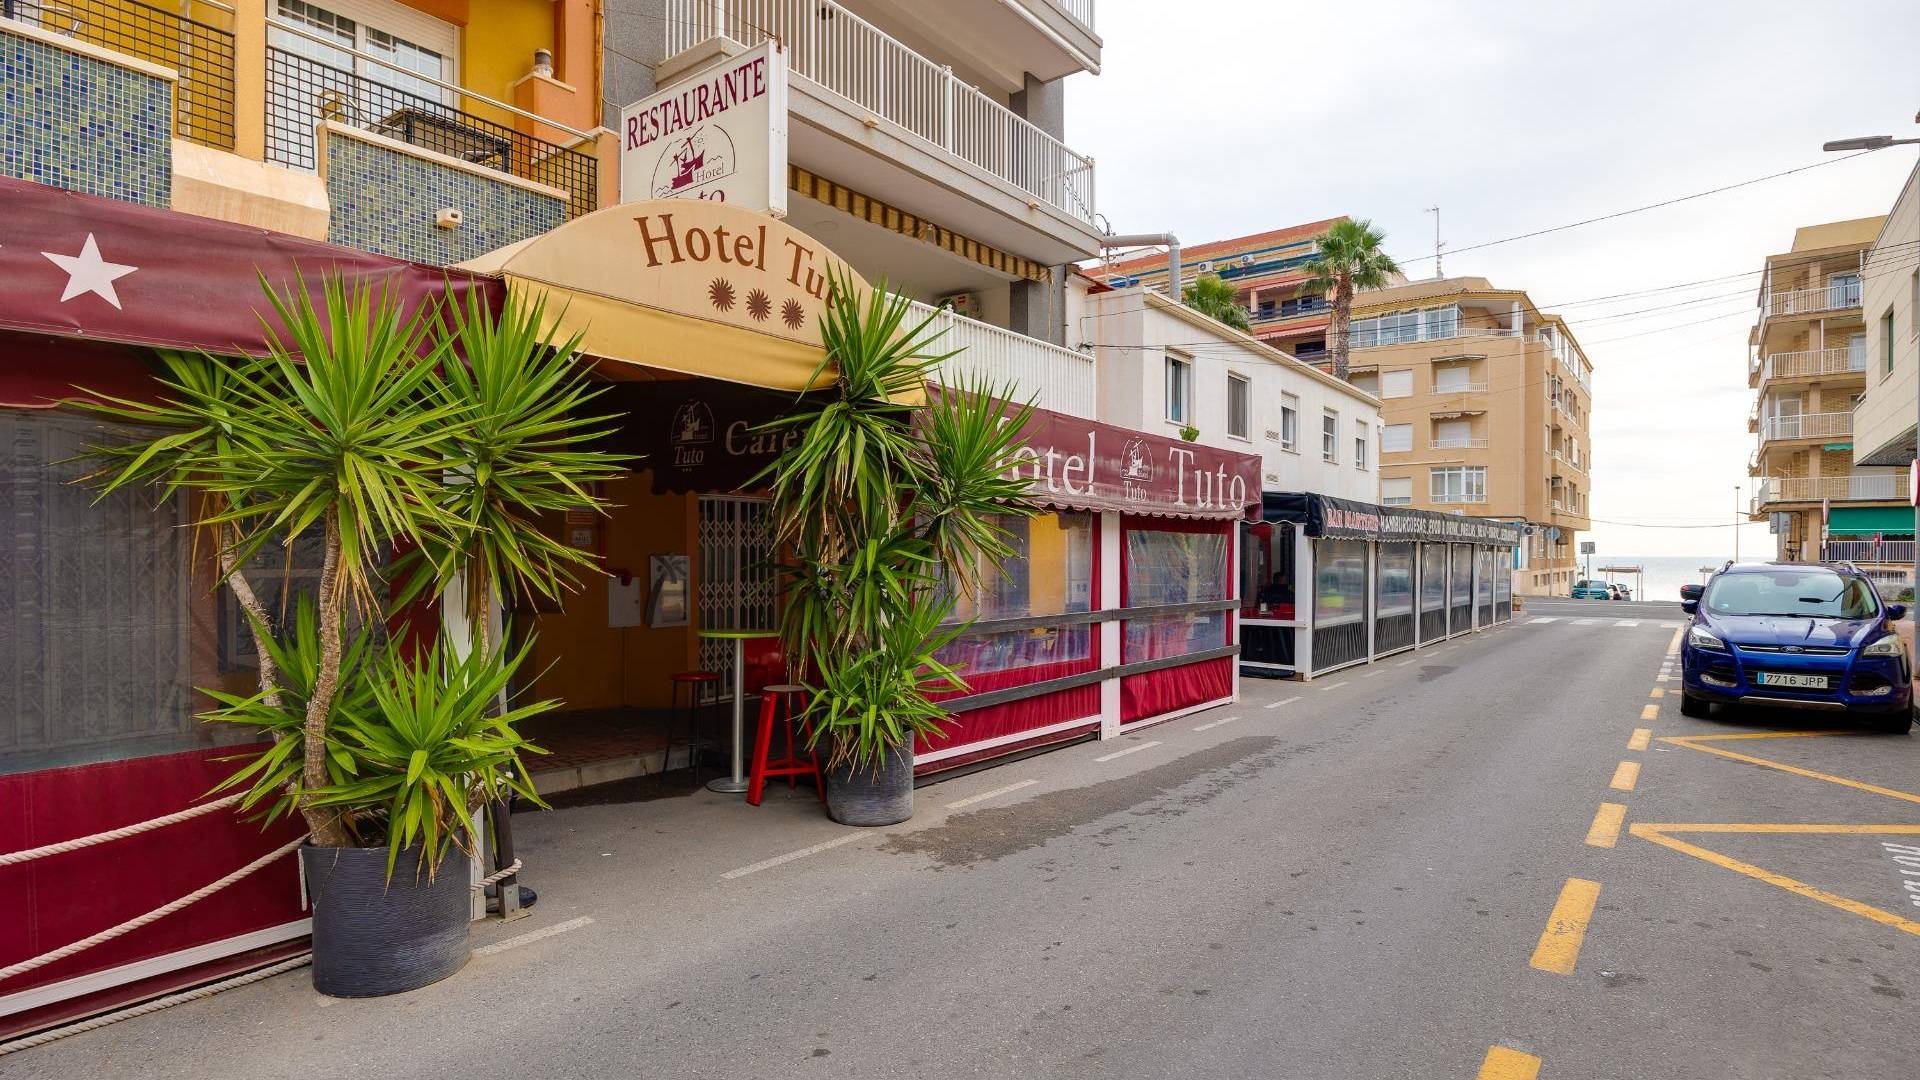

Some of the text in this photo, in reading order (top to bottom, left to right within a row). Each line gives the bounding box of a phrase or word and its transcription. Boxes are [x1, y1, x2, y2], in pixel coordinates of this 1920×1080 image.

[627, 56, 766, 151] RESTAURANTE
[696, 162, 724, 182] Hotel
[633, 213, 766, 272] Hotel
[674, 446, 704, 464] Tuto
[1169, 447, 1246, 511] Tuto
[1124, 481, 1147, 500] Tuto
[1327, 508, 1343, 528] BAR
[1765, 674, 1824, 687] 7716 JPP
